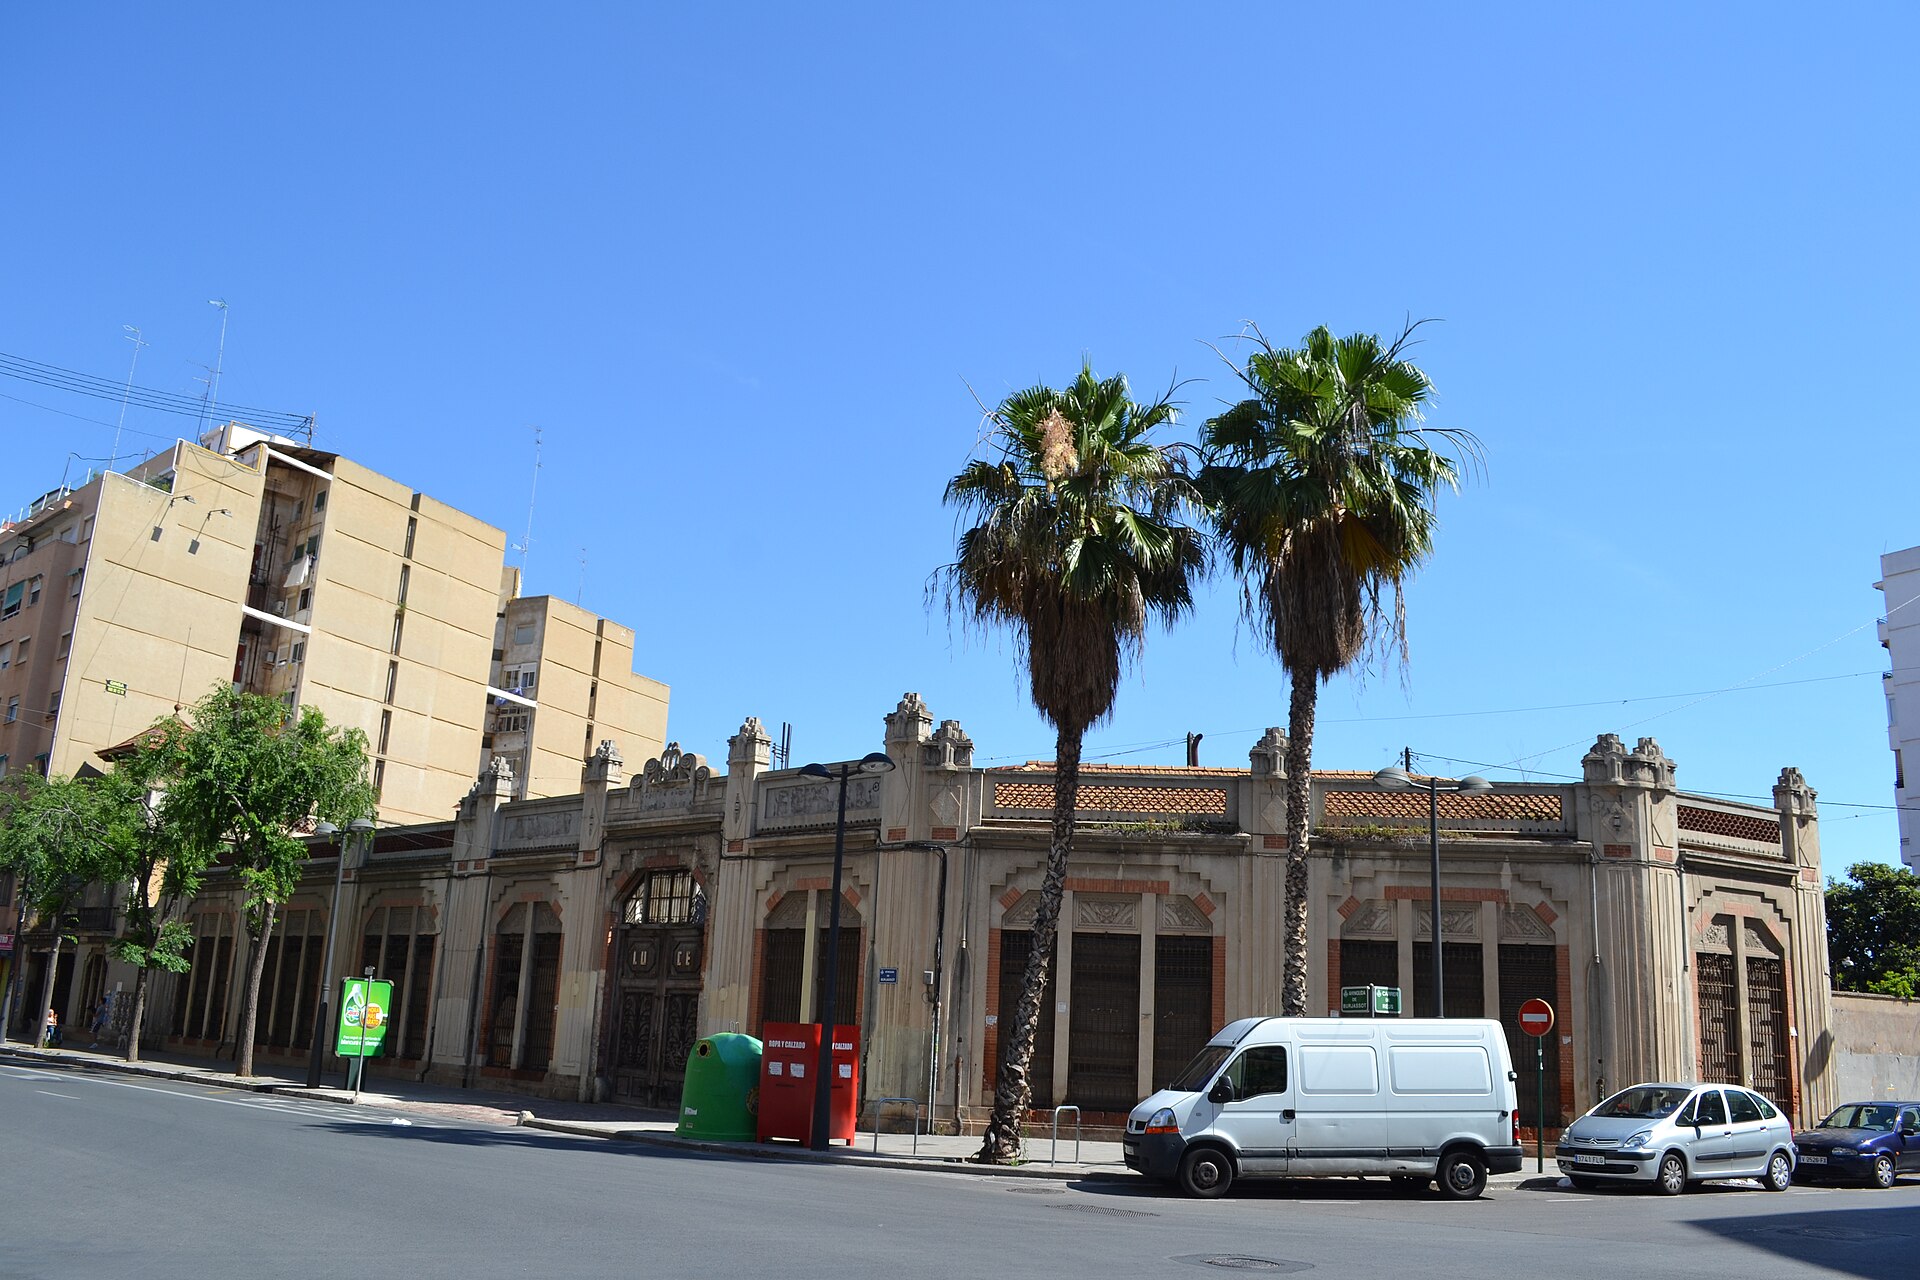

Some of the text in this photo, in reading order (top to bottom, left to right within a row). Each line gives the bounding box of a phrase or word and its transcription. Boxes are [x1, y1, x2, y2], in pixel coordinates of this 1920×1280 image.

[768, 1040, 780, 1048] ROPA
[784, 1041, 806, 1049] CALZADO
[835, 1042, 852, 1050] CALZADO
